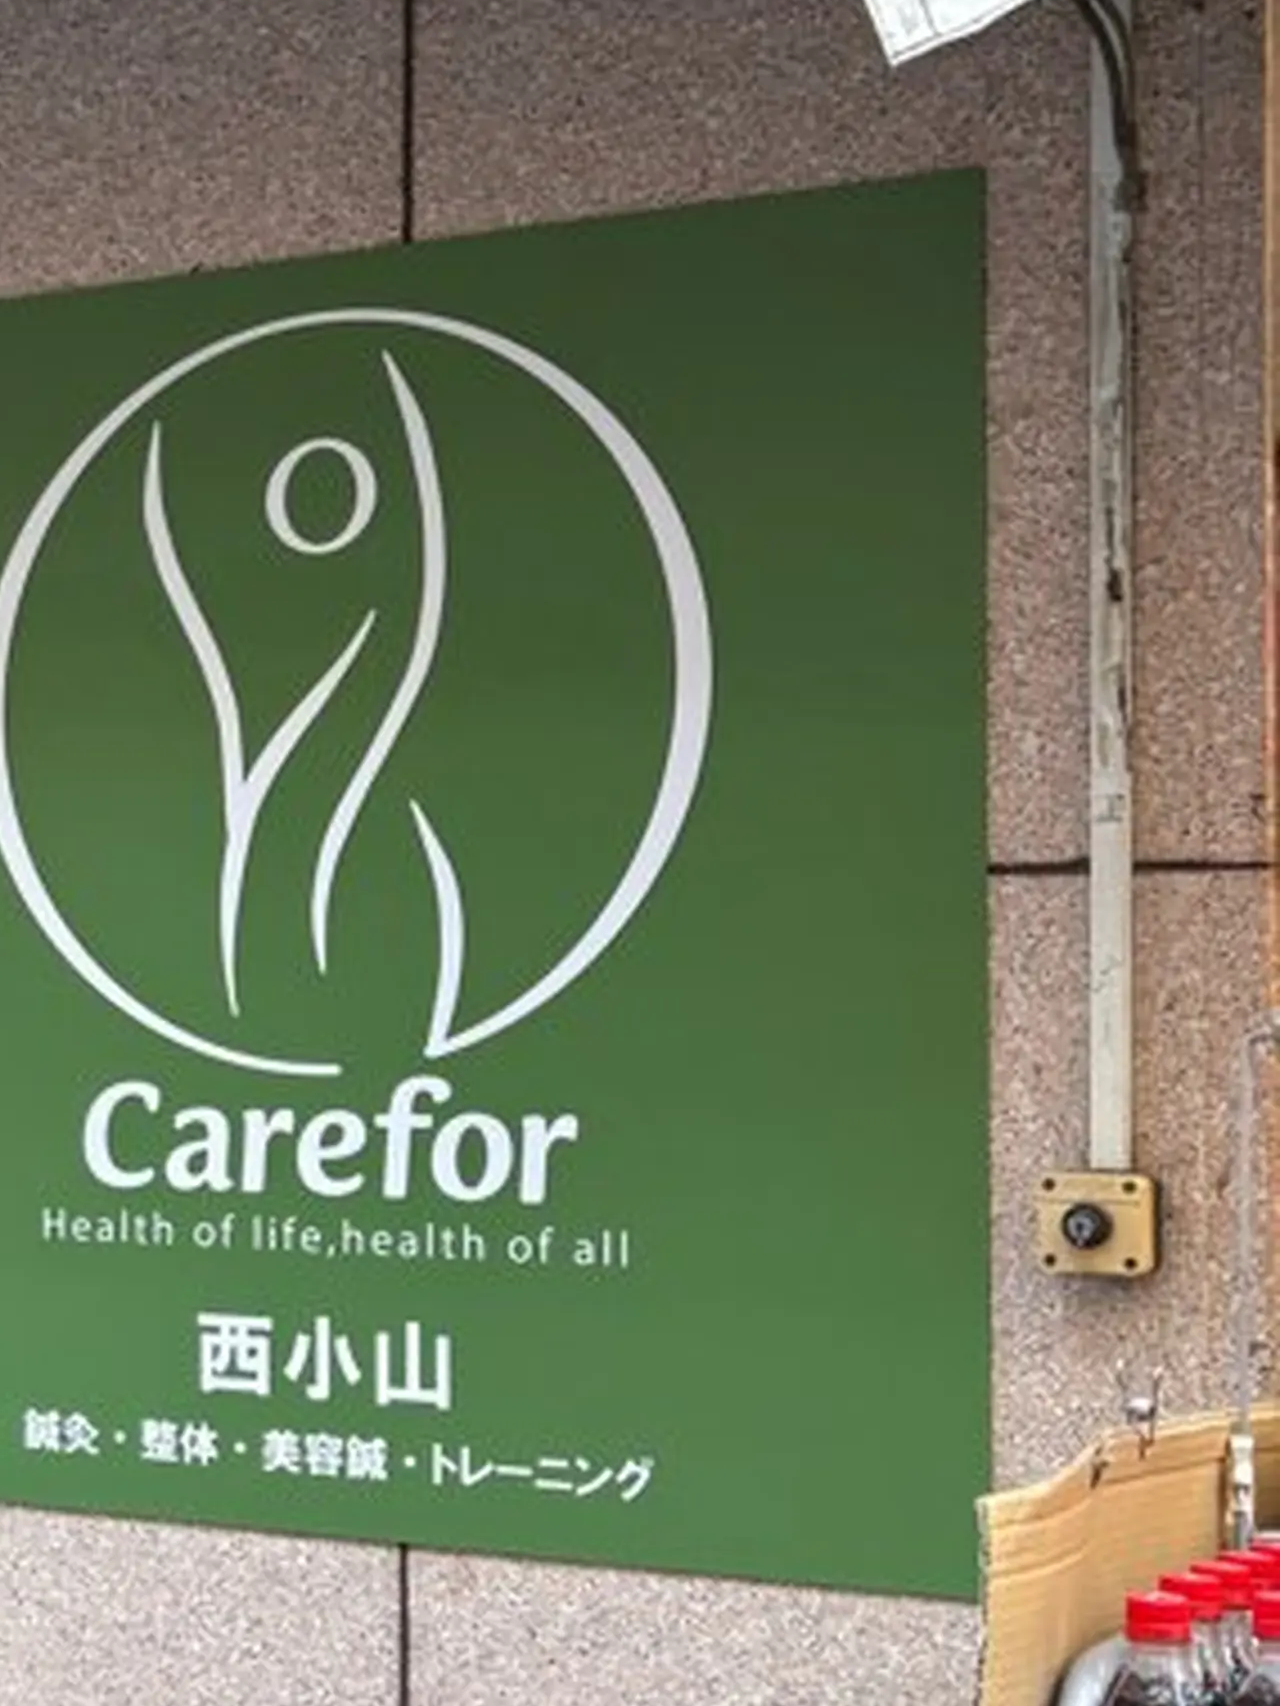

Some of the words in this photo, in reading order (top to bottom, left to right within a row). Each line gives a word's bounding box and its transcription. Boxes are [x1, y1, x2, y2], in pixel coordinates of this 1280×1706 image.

[81, 1073, 580, 1205] Carefor
[42, 1207, 175, 1247] Health
[192, 1213, 236, 1249] of
[507, 1226, 556, 1265] of
[573, 1229, 631, 1269] all
[195, 1311, 453, 1411] 西小山
